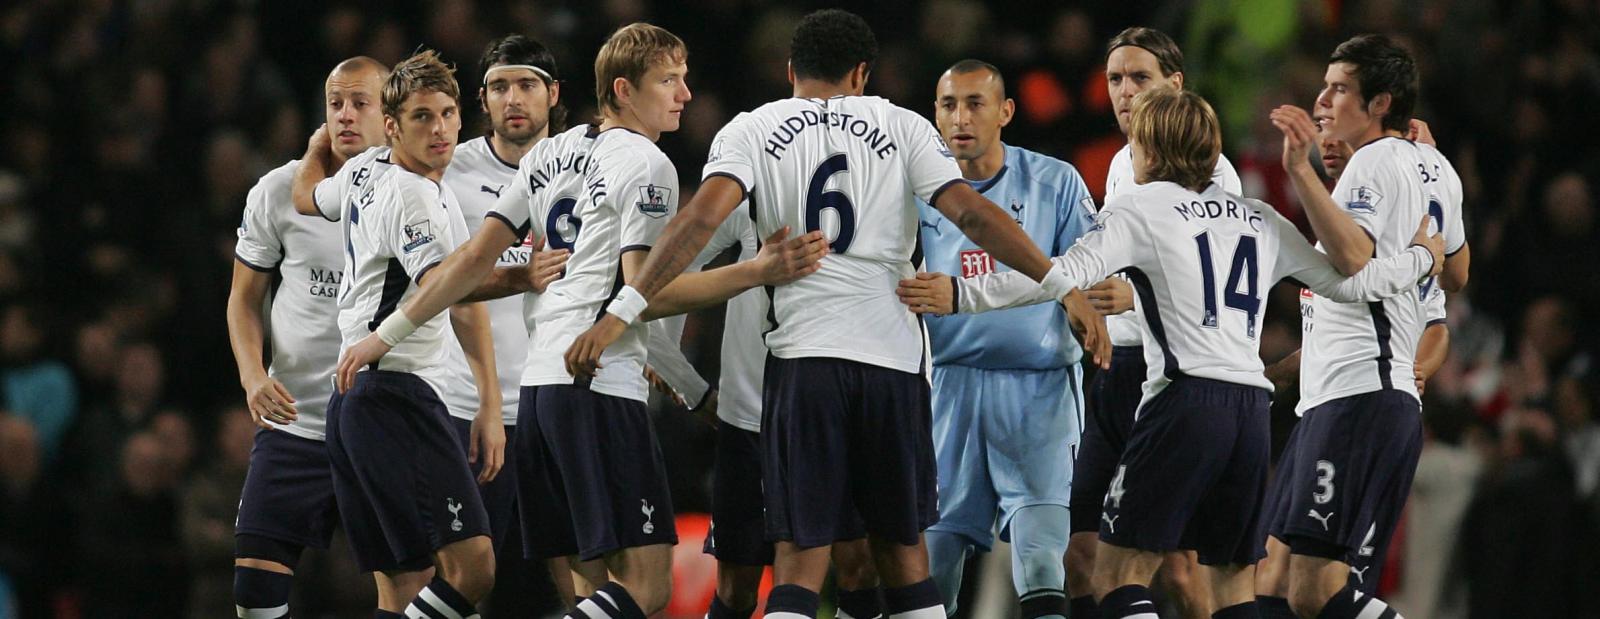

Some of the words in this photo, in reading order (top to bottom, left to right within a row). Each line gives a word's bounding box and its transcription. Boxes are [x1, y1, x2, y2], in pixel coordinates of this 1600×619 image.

[805, 152, 855, 254] 6
[1192, 229, 1263, 339] 14
[1313, 459, 1336, 505] 3
